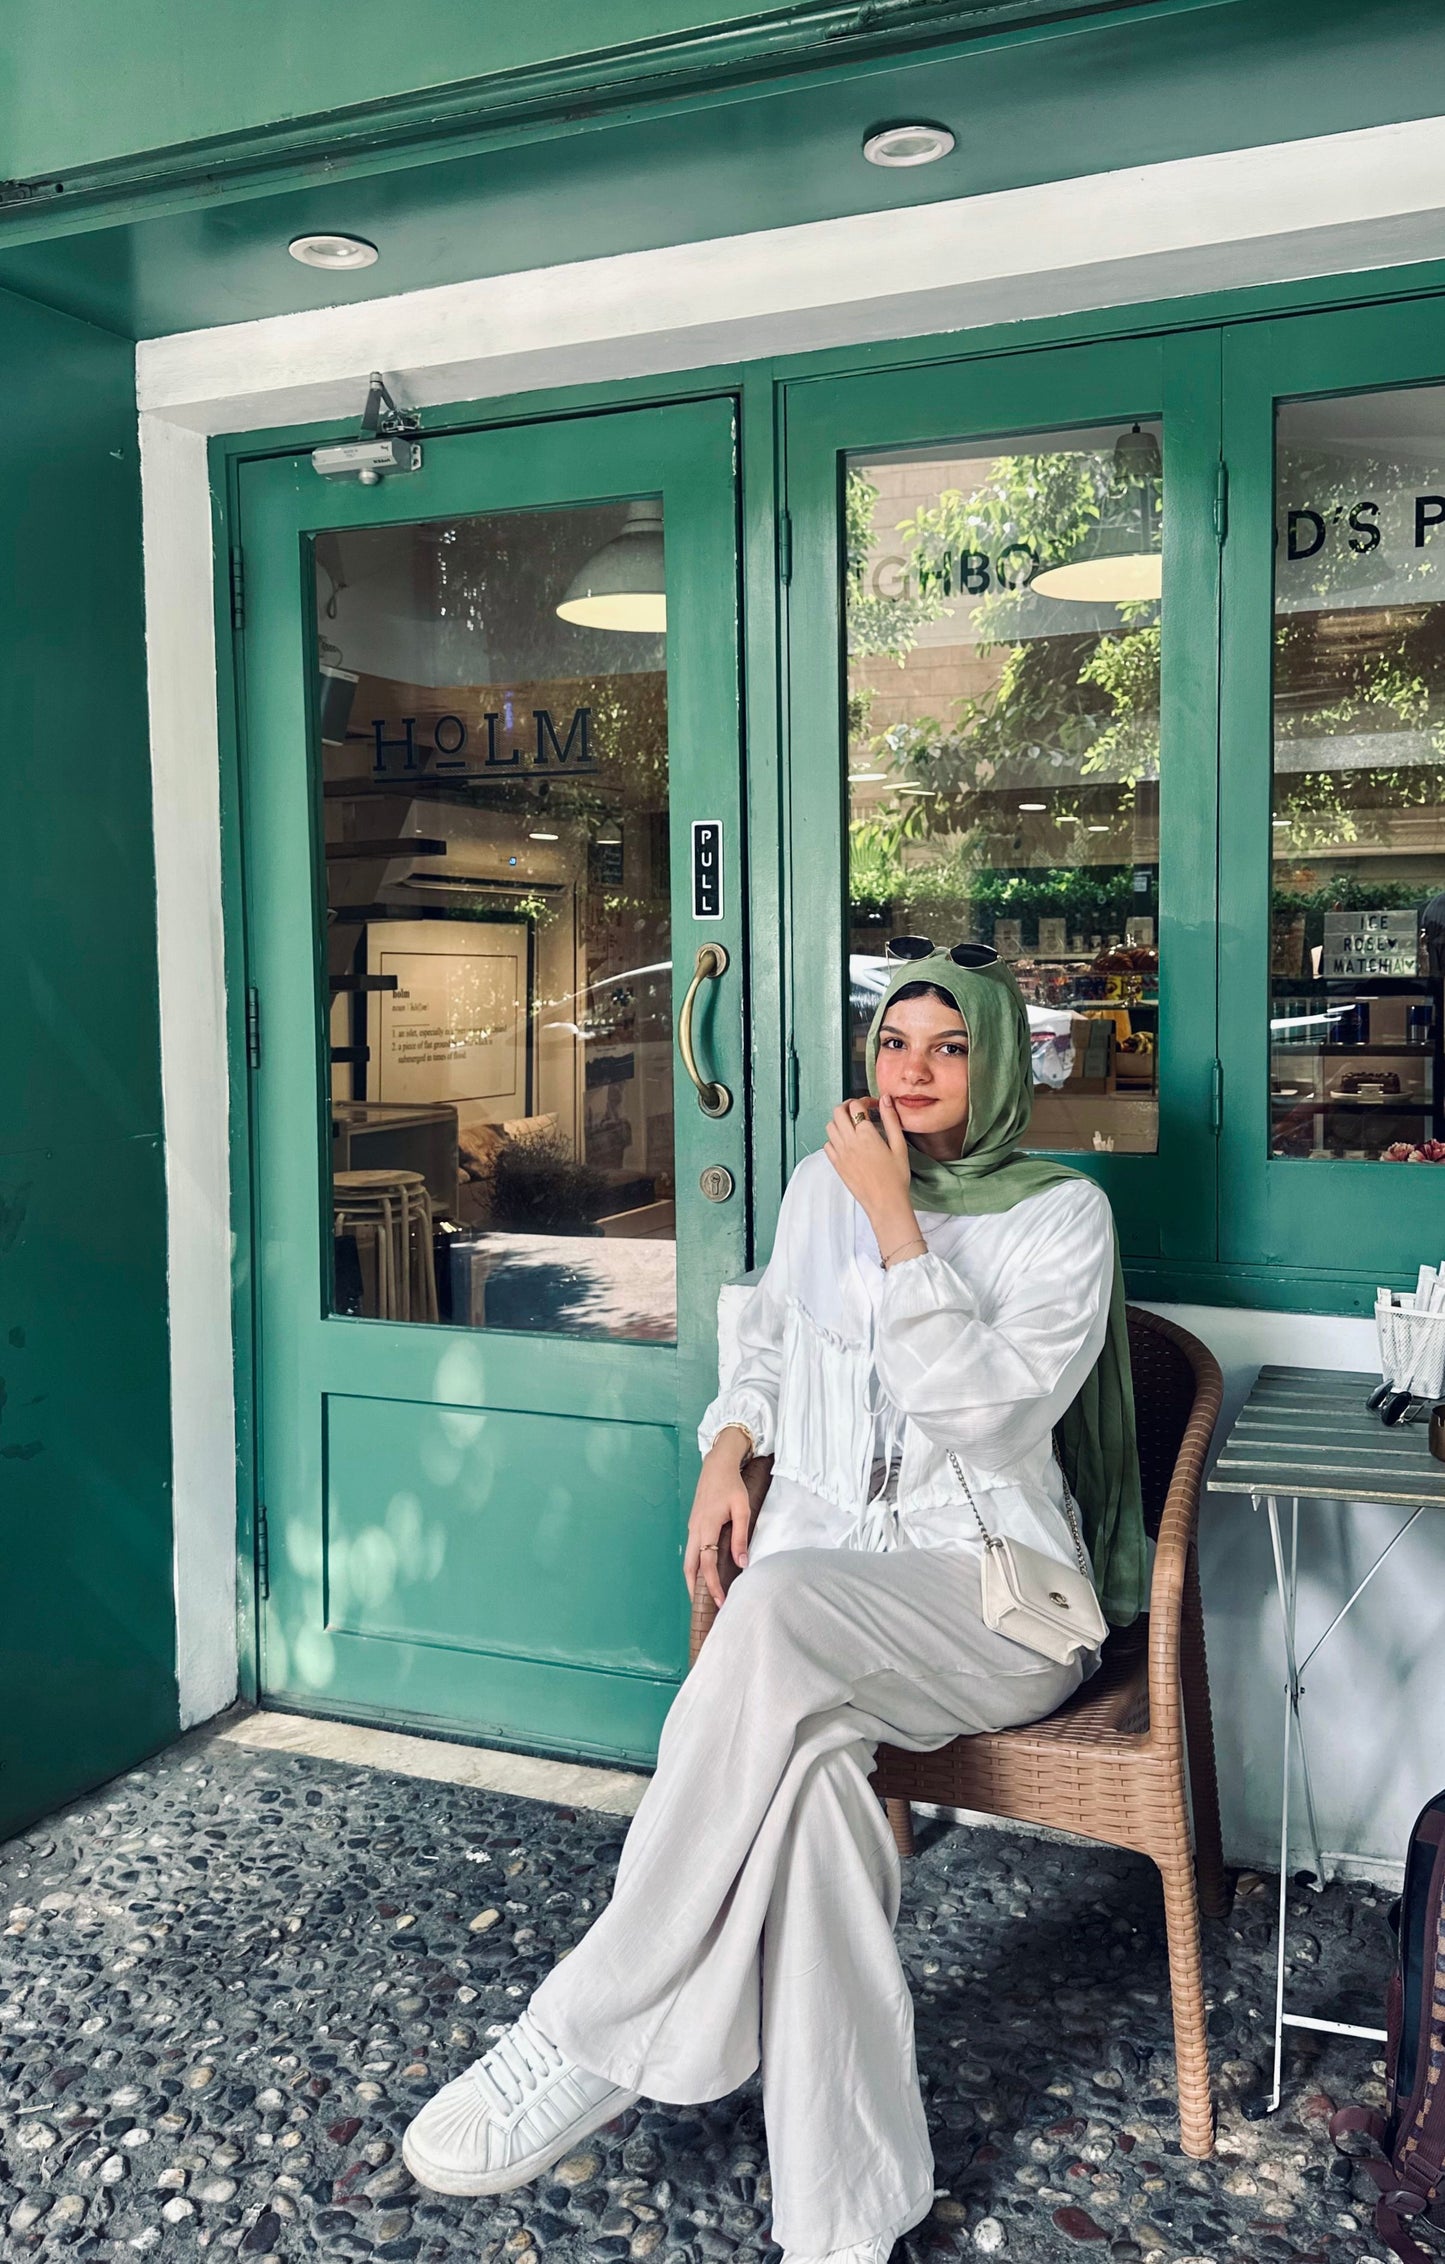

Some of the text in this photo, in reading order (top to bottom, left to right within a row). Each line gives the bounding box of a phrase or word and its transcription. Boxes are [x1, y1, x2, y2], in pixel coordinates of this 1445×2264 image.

[701, 830, 712, 911] PULL
[1361, 915, 1389, 930] ICE
[1344, 937, 1386, 952] ROSE
[1334, 958, 1402, 973] MATCHA
